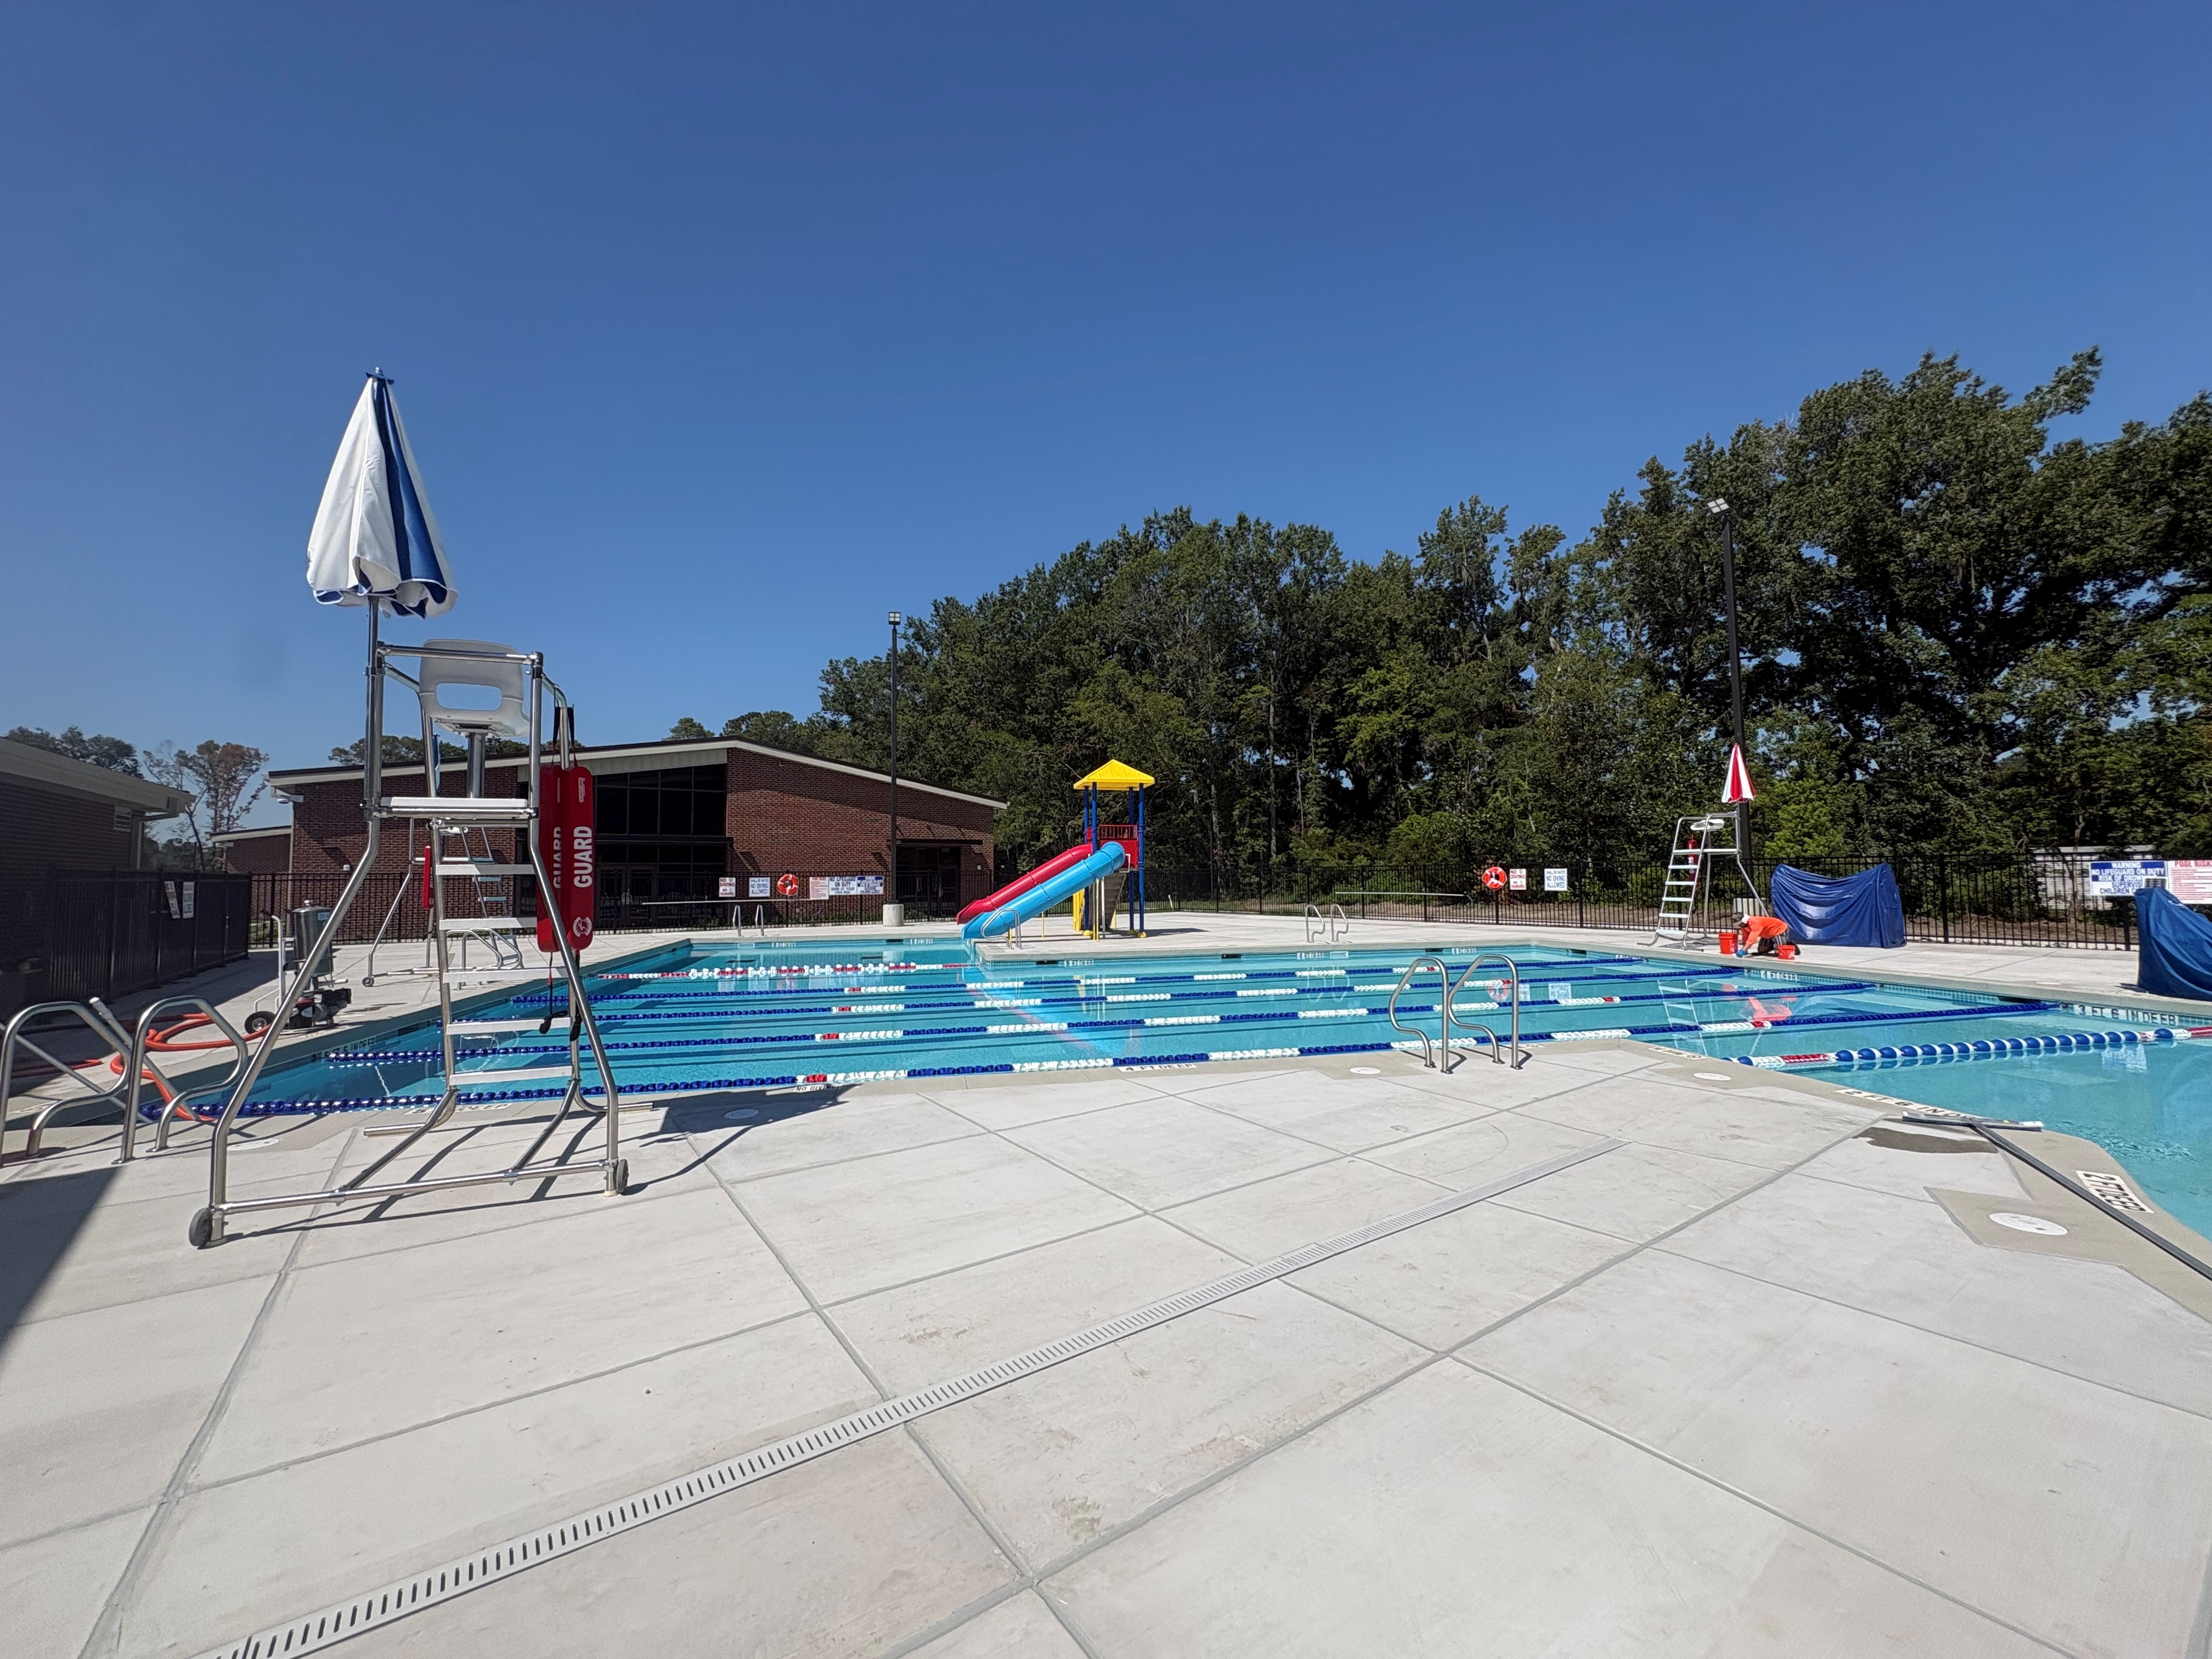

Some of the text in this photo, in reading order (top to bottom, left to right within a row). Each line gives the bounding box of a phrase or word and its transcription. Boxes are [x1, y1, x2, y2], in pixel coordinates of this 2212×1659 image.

[574, 826, 593, 888] GUARD
[2078, 1005, 2176, 1025] 3 FT 6 IN DEEP
[2095, 1188, 2147, 1212] DEEP
